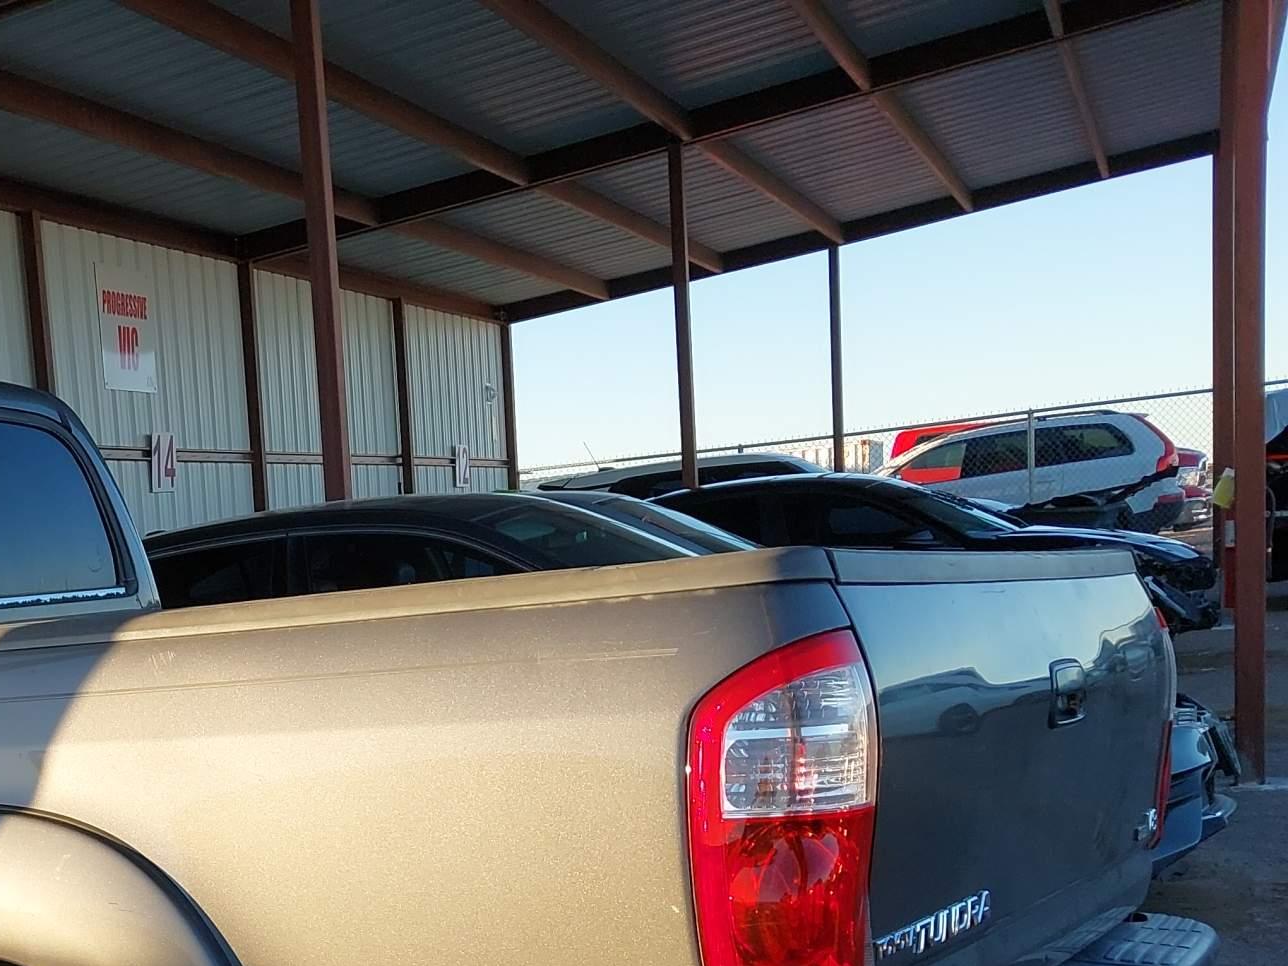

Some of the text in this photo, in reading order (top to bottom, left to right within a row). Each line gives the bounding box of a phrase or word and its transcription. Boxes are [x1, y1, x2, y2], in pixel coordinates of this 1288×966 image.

[102, 289, 148, 320] PROGRESSIVE
[117, 325, 141, 371] VIC
[153, 434, 176, 489] 14
[456, 447, 469, 485] 12
[915, 889, 991, 954] TUNDRA
